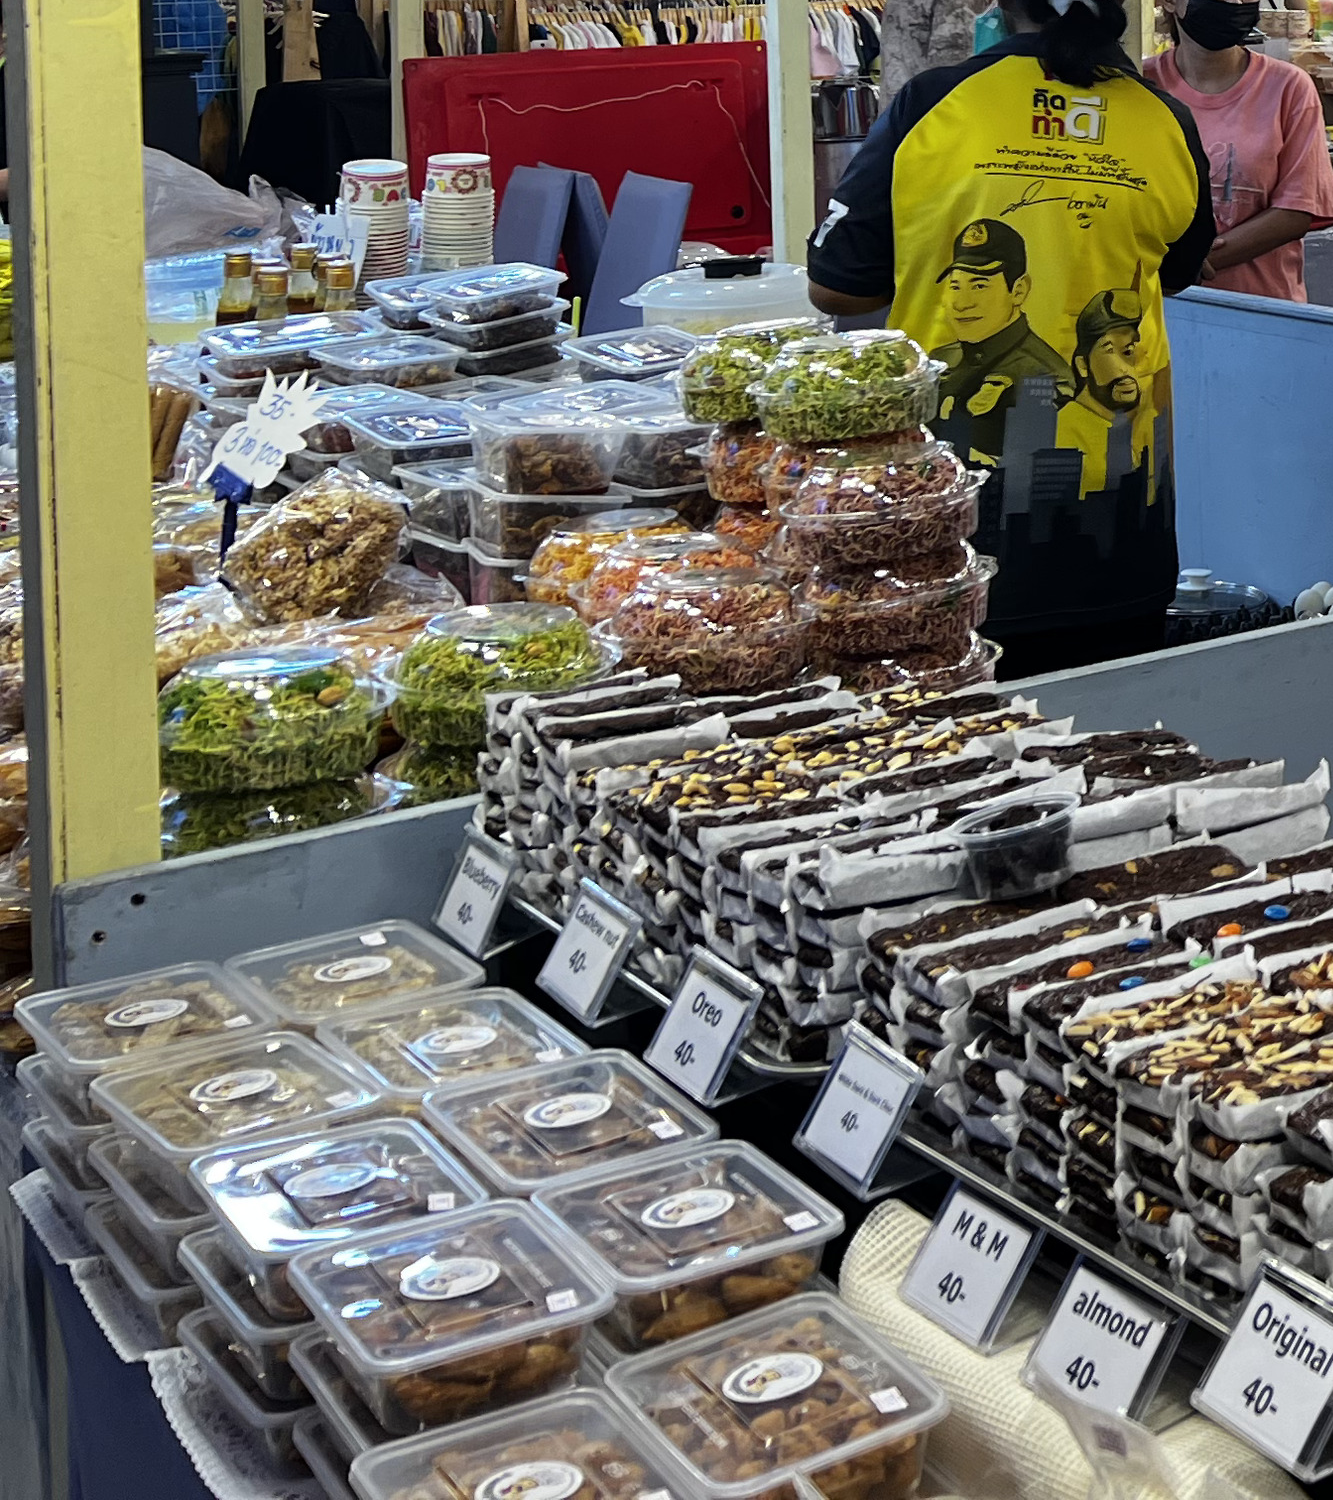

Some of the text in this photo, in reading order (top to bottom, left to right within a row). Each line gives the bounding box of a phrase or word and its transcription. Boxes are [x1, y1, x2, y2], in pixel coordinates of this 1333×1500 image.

[1032, 88, 1067, 111] คิด
[224, 426, 248, 453] 3
[461, 857, 502, 900] Blueberry
[575, 904, 622, 950] Cashew nut
[692, 991, 723, 1027] Oreo
[953, 1210, 1009, 1263] M & M
[1072, 1290, 1155, 1350] almond
